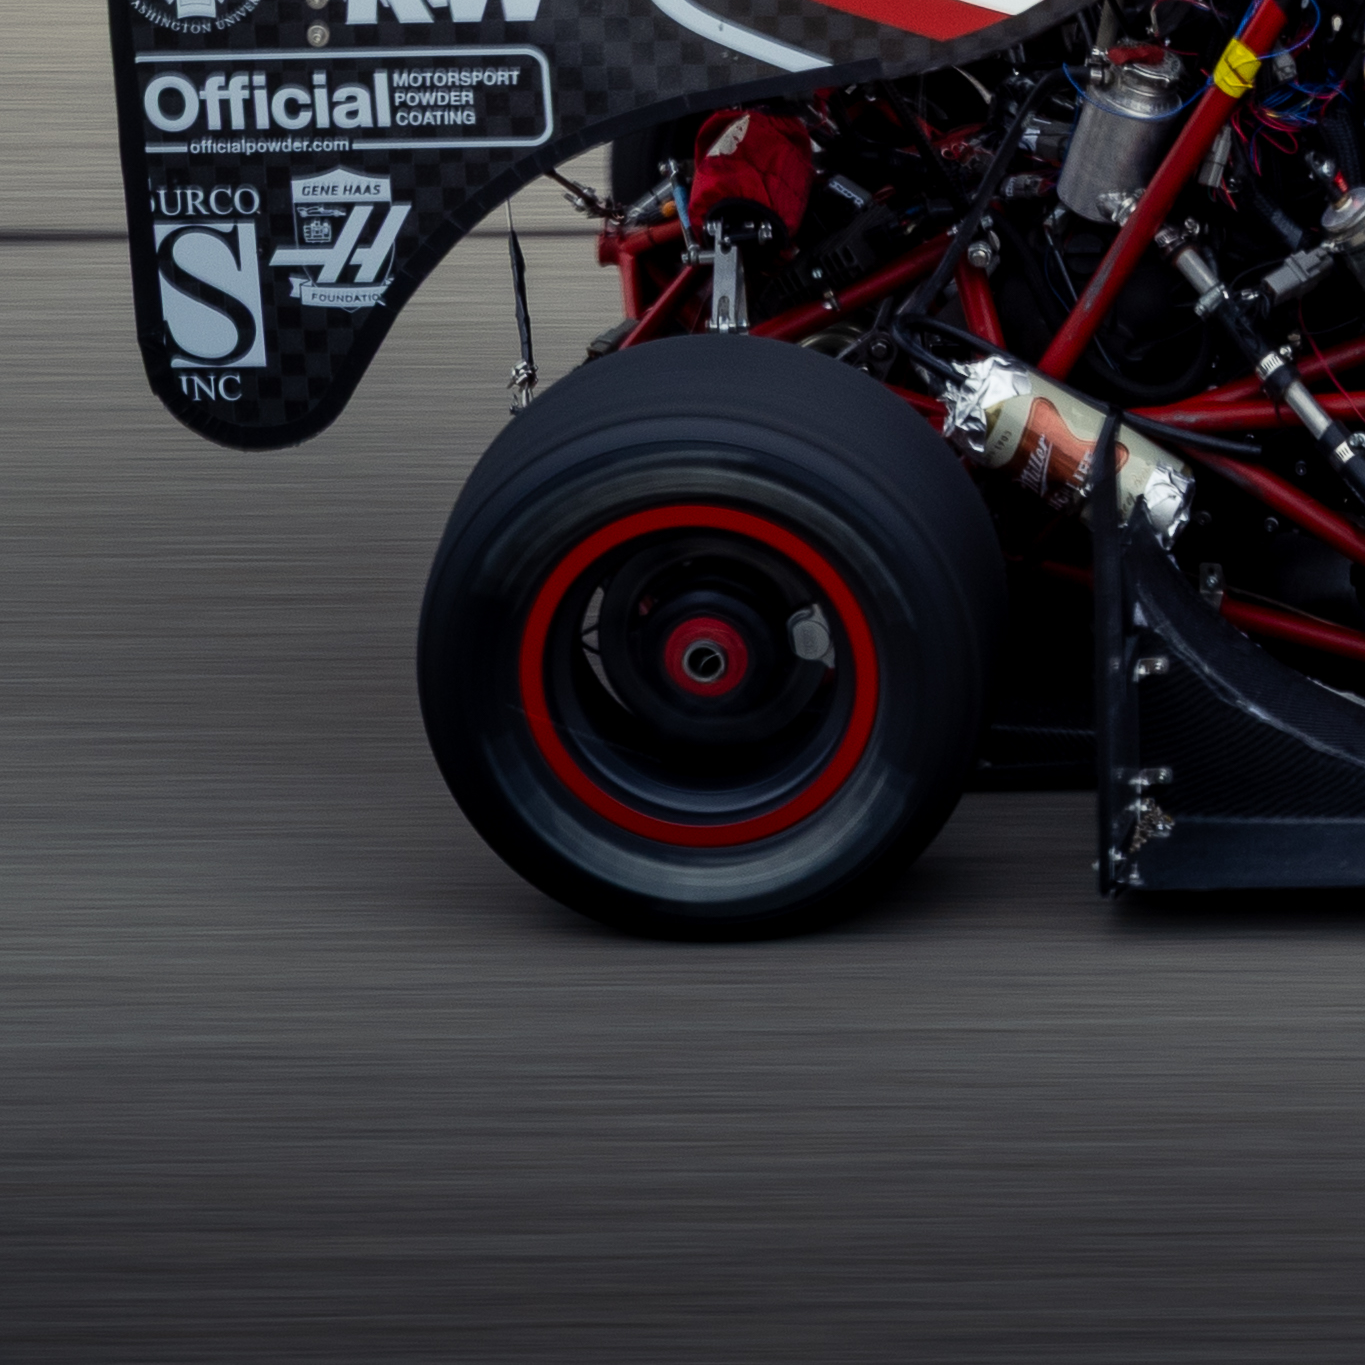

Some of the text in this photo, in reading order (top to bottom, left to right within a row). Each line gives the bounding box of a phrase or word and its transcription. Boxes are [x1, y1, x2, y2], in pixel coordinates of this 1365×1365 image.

[392, 69, 520, 87] MOTORSPORT
[144, 71, 391, 132] Official
[394, 90, 475, 107] POWDER
[395, 110, 476, 126] COATING
[189, 138, 350, 156] officialpowder.com
[301, 184, 382, 196] GENE HAAS
[311, 292, 380, 304] FOUNDATIO
[178, 373, 243, 402] INC
[1016, 434, 1048, 493] Miller
